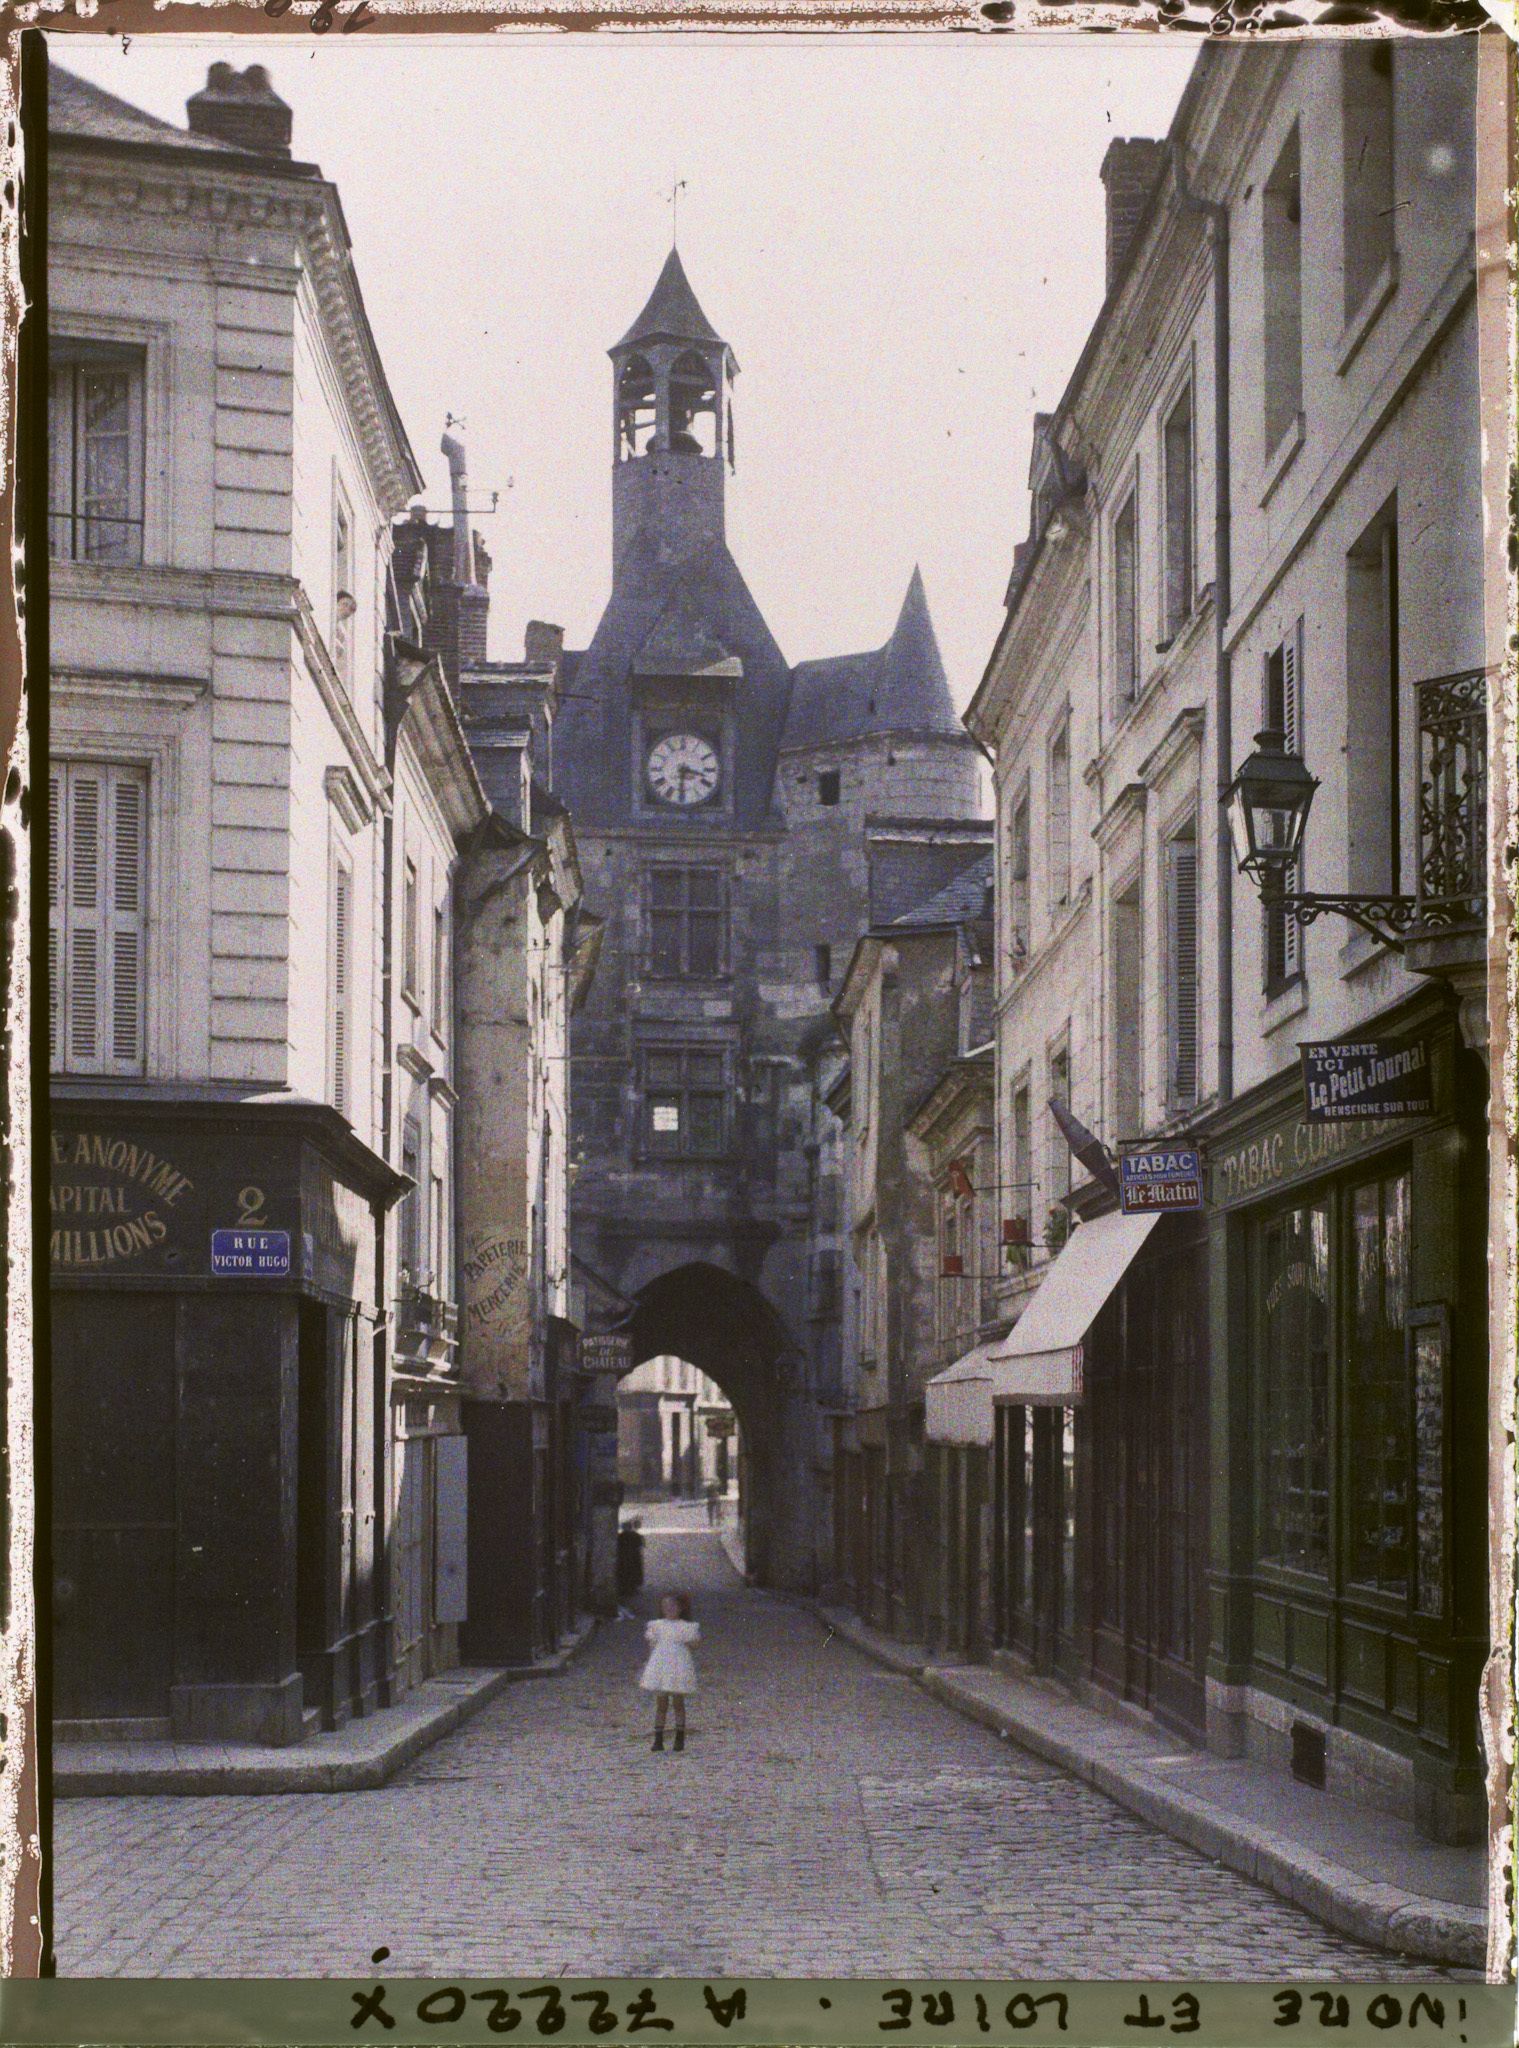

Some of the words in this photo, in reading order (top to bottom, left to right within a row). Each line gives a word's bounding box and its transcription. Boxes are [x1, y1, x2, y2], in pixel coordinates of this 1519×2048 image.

[1308, 1047, 1327, 1059] EN
[1331, 1043, 1378, 1057] VENTE
[1316, 1058, 1344, 1072] ICI
[1309, 1081, 1328, 1111] Le
[1330, 1066, 1366, 1102] Petit
[1367, 1041, 1426, 1087] Journal
[1324, 1102, 1381, 1117] RENSEIGNE
[1384, 1100, 1404, 1113] SUR
[74, 1133, 194, 1206] ANONYME
[1127, 1153, 1193, 1173] TABAC
[1224, 1133, 1284, 1197] TABAC
[1126, 1185, 1146, 1206] Le
[1147, 1183, 1197, 1203] Matin
[237, 1186, 268, 1226] 2
[234, 1237, 268, 1250] RUE
[214, 1254, 253, 1268] VICTOR
[259, 1254, 288, 1268] HUGO
[1124, 1993, 1202, 2033] ET
